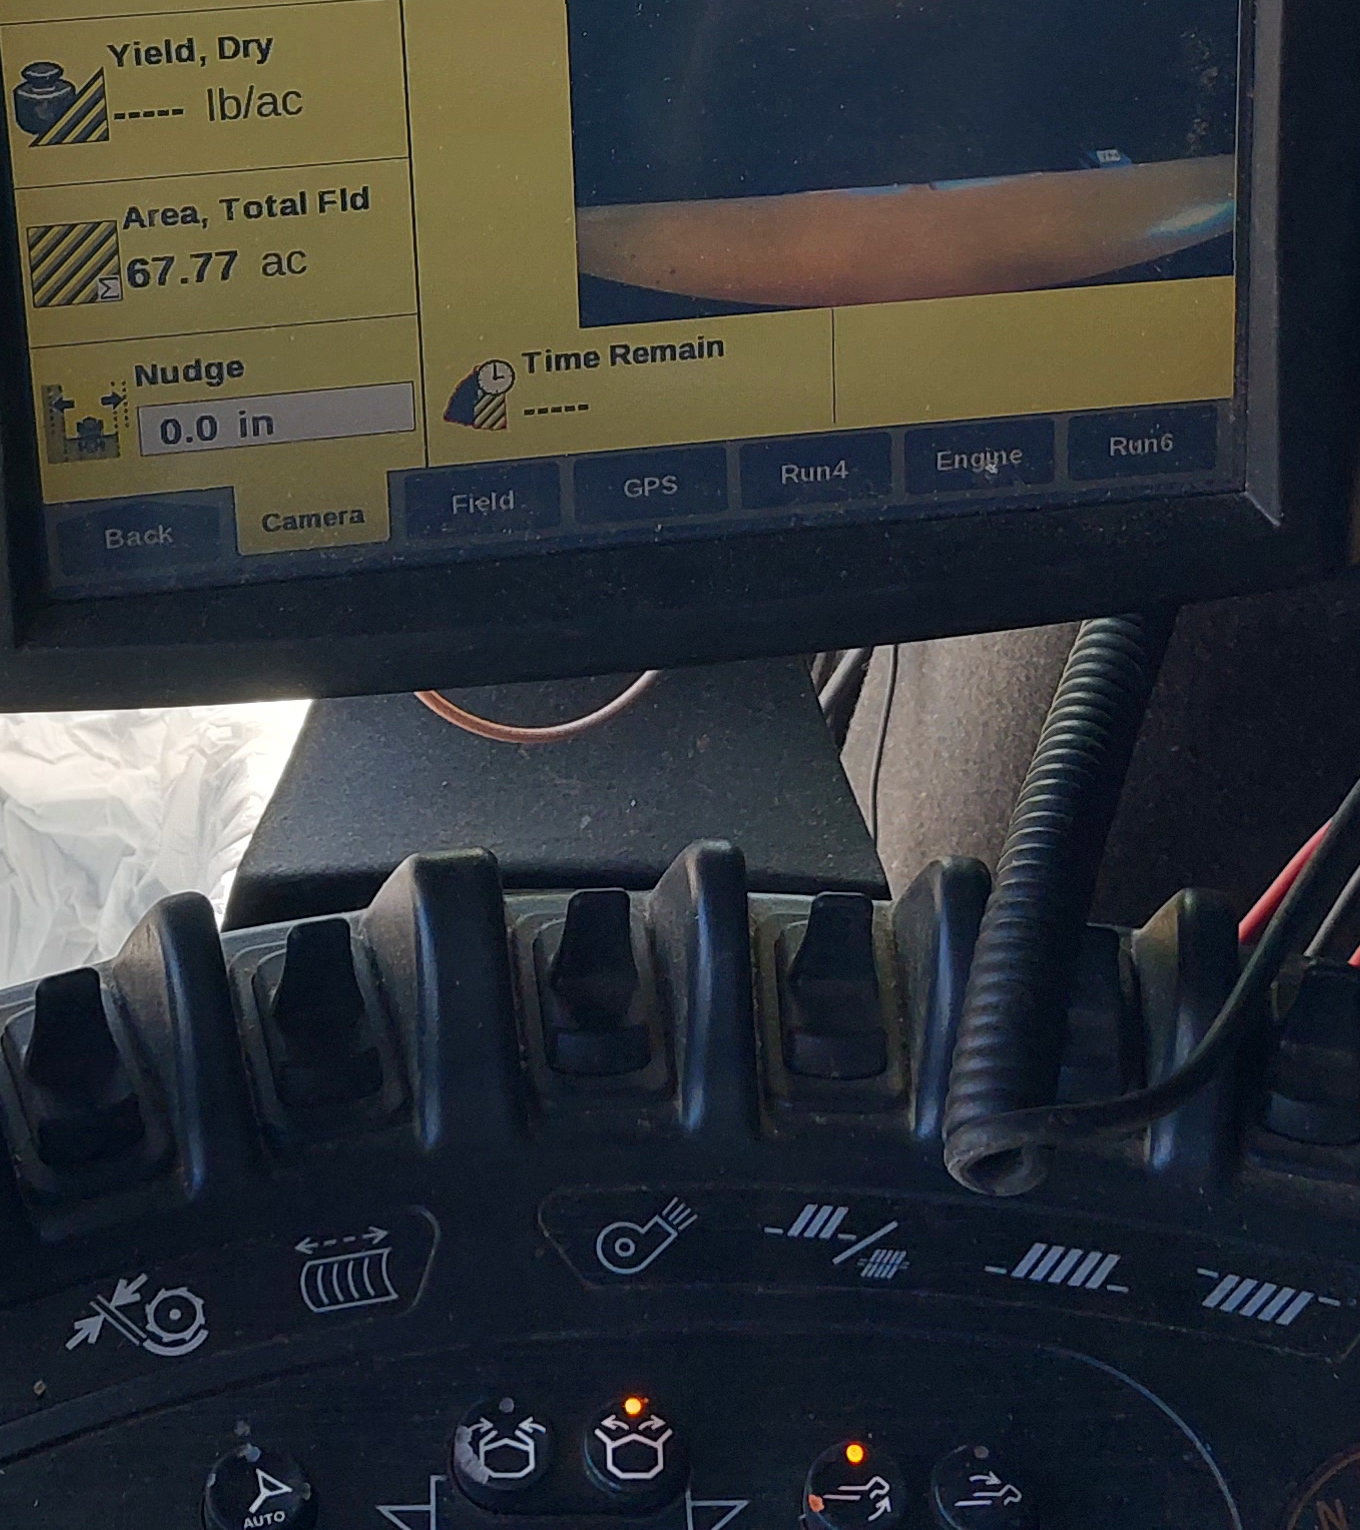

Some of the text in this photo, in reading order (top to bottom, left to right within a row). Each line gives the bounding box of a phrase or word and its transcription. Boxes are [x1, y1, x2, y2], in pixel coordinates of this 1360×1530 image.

[107, 33, 275, 68] Yield, Dry
[207, 86, 304, 124] lb/ac
[122, 185, 371, 232] Area, Total Fld
[126, 249, 309, 290] 67.77 ac
[521, 334, 726, 375] Time Remain
[134, 355, 245, 389] Nudge
[159, 410, 275, 446] 0.0 in
[936, 444, 1024, 474] Engine
[1108, 432, 1175, 456] Run6
[622, 474, 679, 499] GPS
[780, 459, 850, 485] Run4
[451, 489, 516, 515] Field
[261, 505, 366, 534] Camera
[104, 523, 174, 551] Back
[243, 1511, 286, 1530] AUTO
